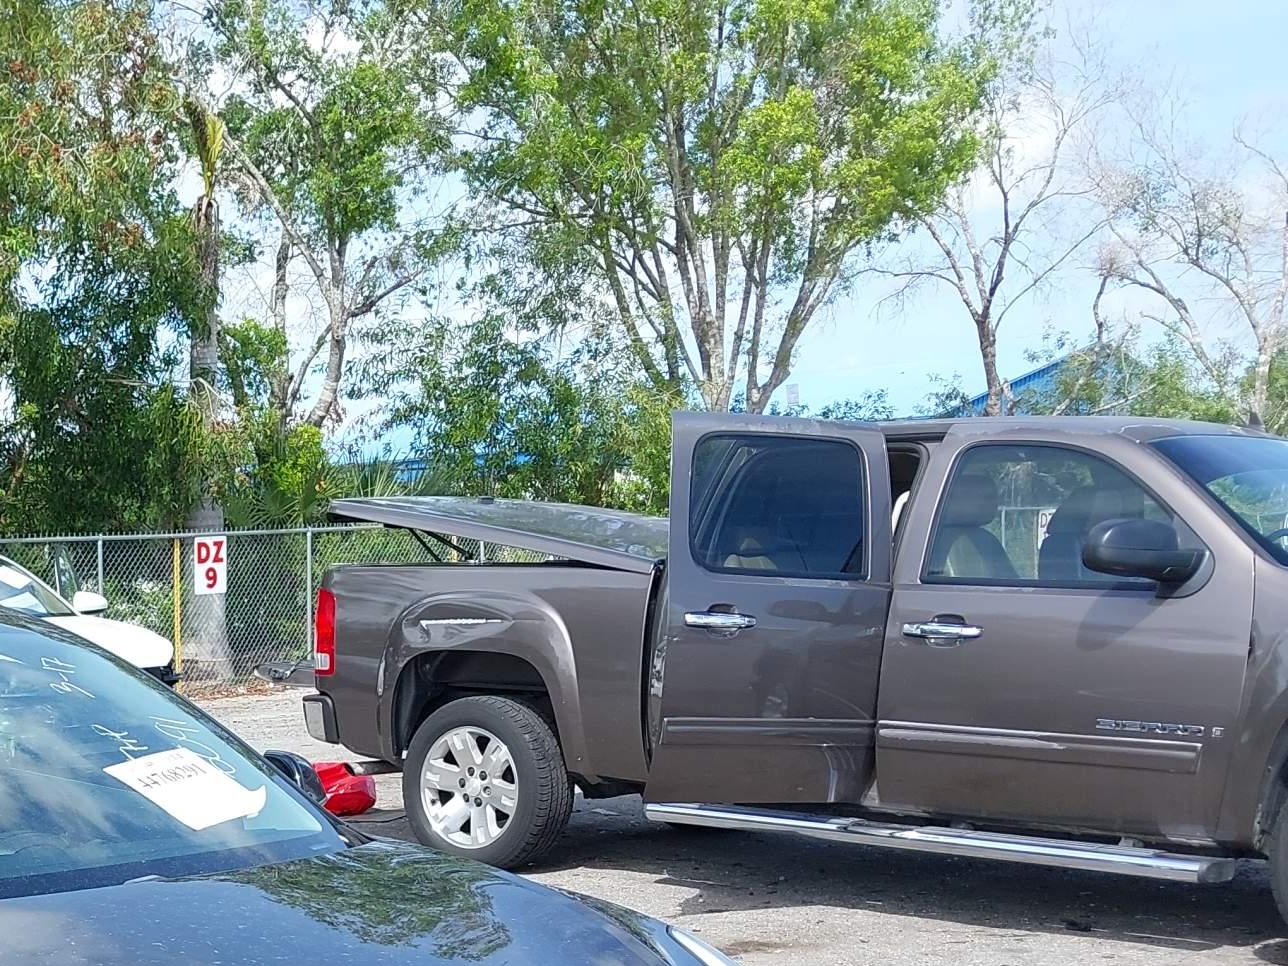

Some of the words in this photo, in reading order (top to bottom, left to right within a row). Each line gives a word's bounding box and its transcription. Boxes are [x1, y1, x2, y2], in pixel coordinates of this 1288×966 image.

[197, 541, 224, 564] DZ
[205, 567, 217, 589] 9
[1095, 718, 1205, 737] SIERRA
